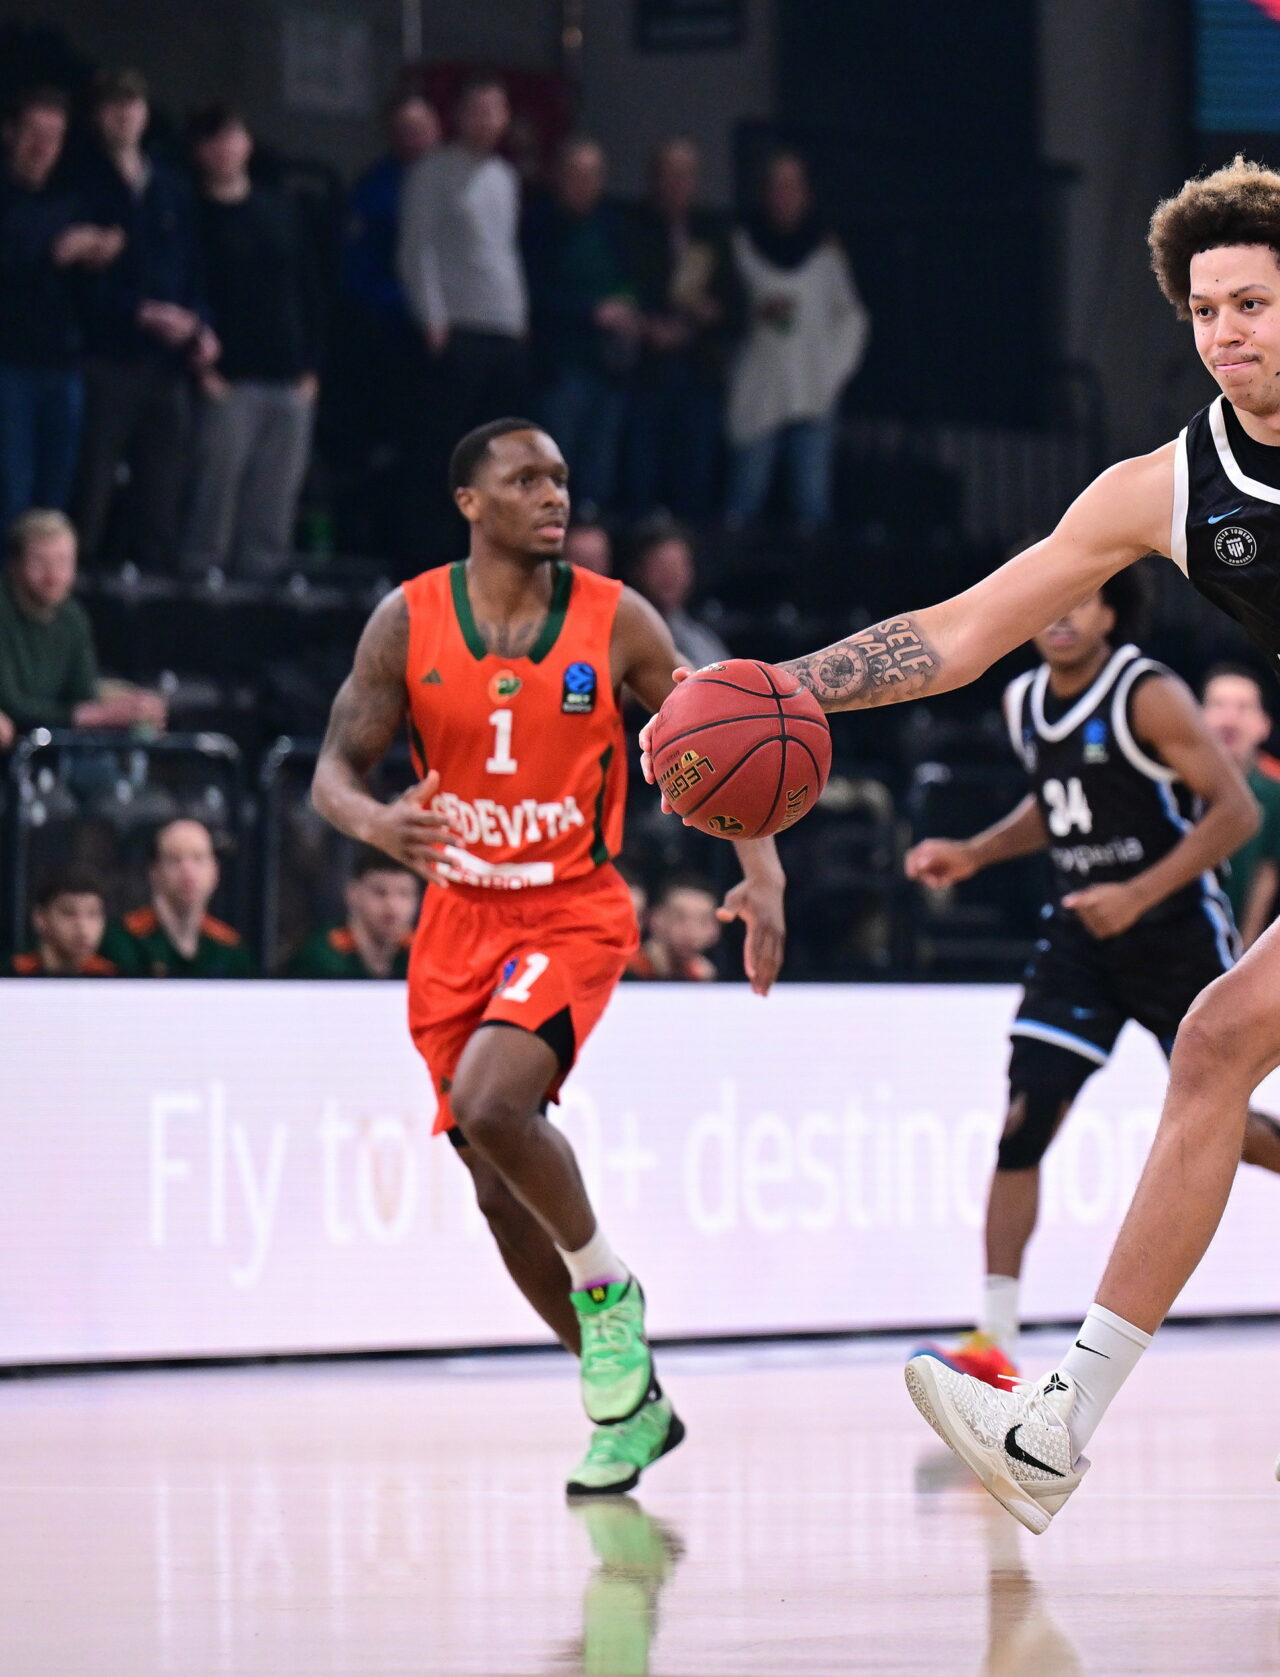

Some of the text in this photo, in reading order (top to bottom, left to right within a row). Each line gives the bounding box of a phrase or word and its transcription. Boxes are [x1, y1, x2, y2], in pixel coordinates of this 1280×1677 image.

[877, 618, 935, 671] SELF
[485, 709, 518, 774] 1
[501, 953, 550, 1003] 1
[149, 1080, 289, 1289] Fly
[319, 1095, 416, 1244] to
